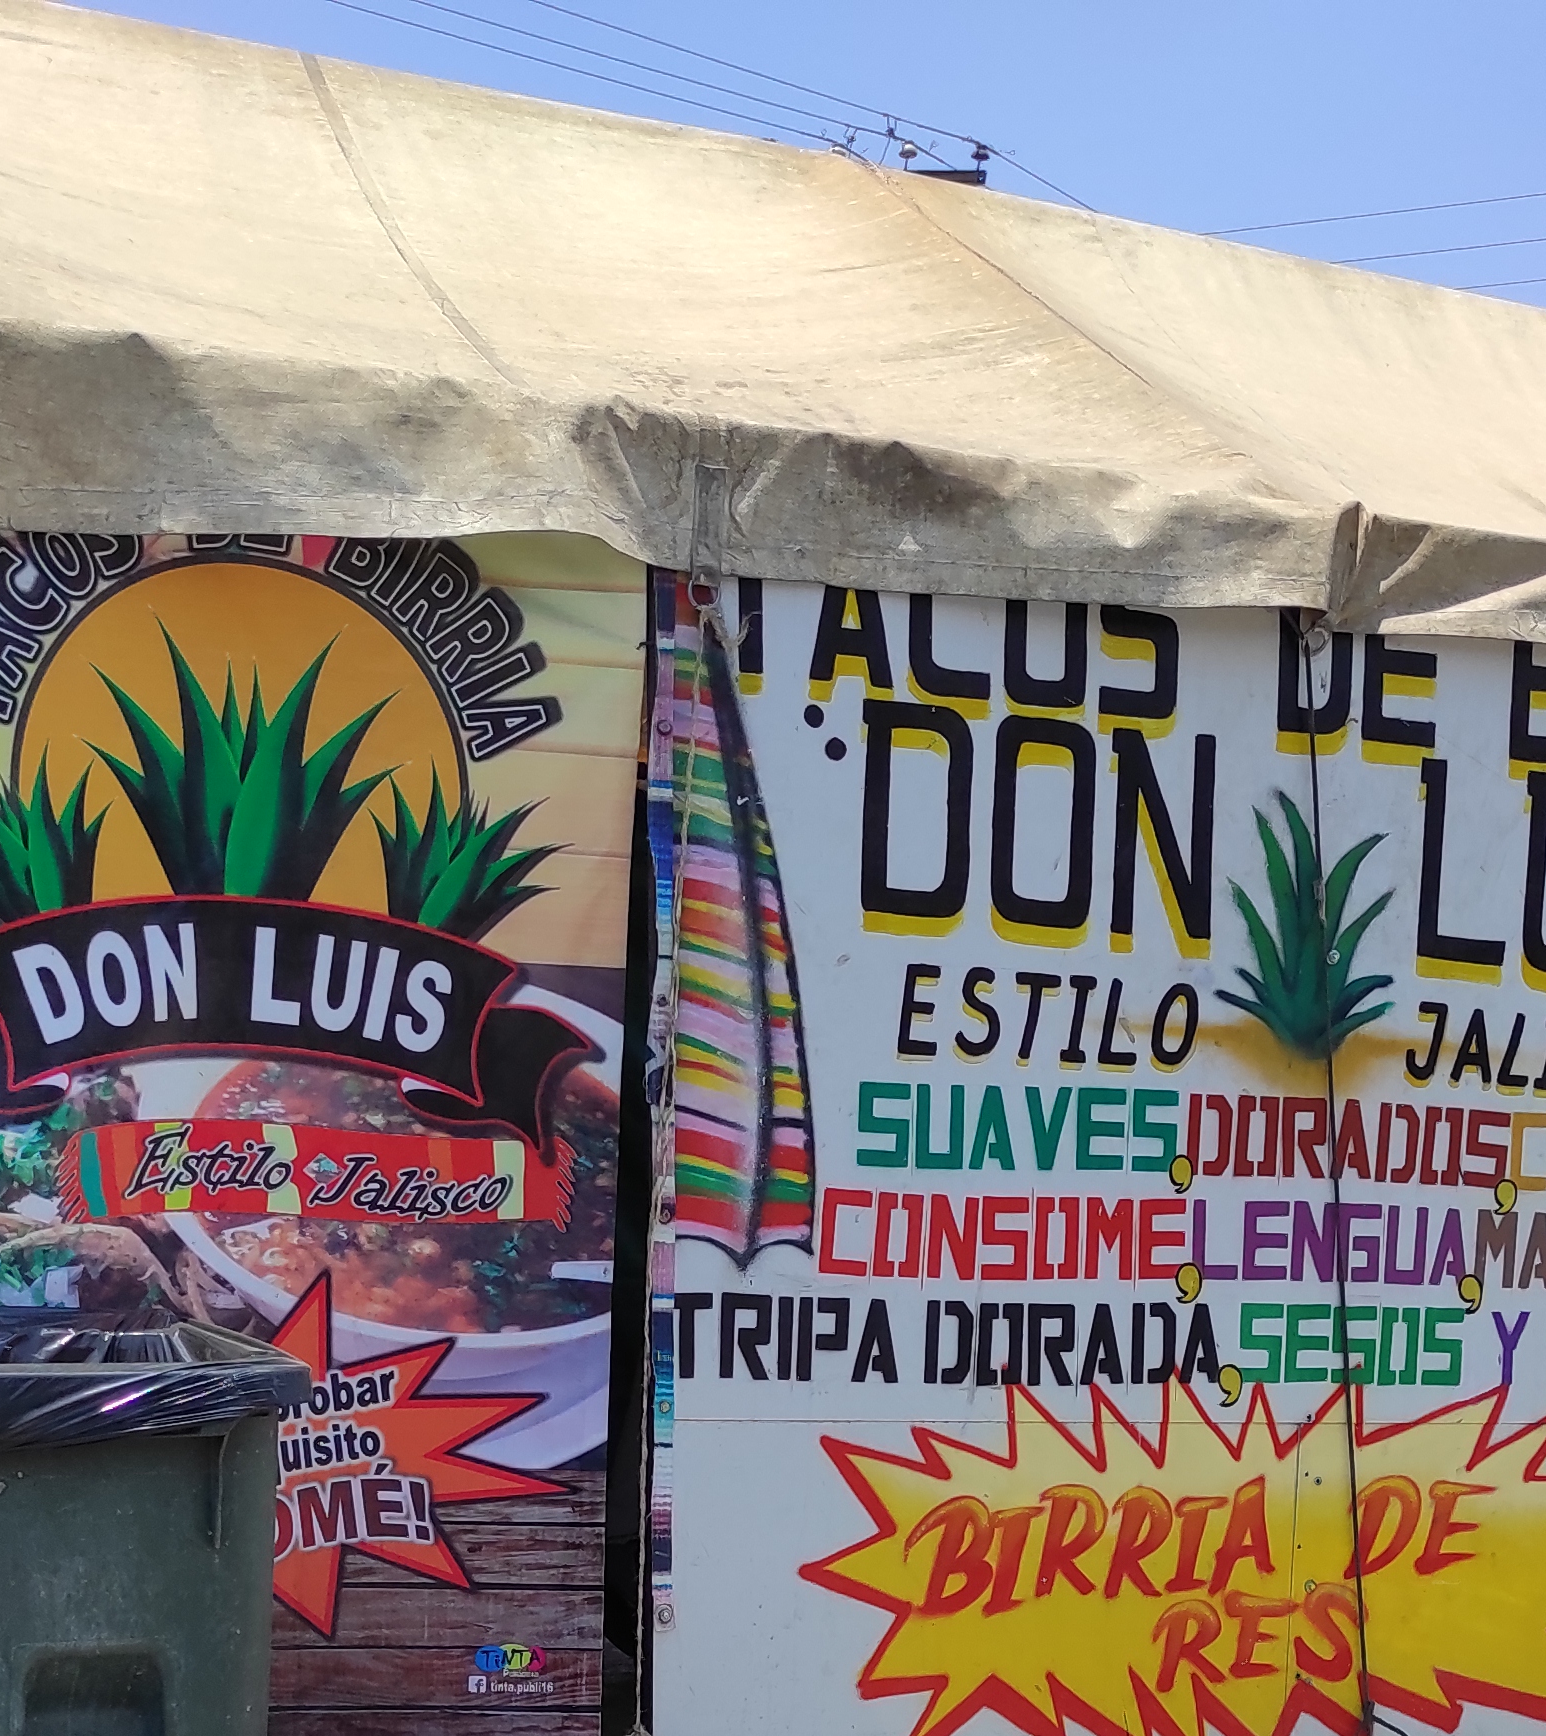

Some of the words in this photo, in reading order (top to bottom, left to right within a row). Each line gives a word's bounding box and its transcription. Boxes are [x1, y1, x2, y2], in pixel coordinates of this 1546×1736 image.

[325, 537, 562, 762] BIRRIA
[1276, 608, 1438, 766] DE
[861, 698, 1216, 960] DON
[12, 922, 200, 1046] DON
[251, 926, 454, 1054] LUIS
[896, 962, 1200, 1074] ESTILO
[125, 1125, 294, 1200] Estilo
[308, 1154, 514, 1222] Jalisco
[278, 1370, 395, 1422] obar
[672, 1291, 899, 1383] TRIPA
[1239, 1302, 1466, 1386] SESOS
[1490, 1310, 1531, 1386] Y
[902, 1474, 1275, 1618] BIRRIA
[1345, 1474, 1498, 1580] DE
[1151, 1582, 1370, 1692] RES
